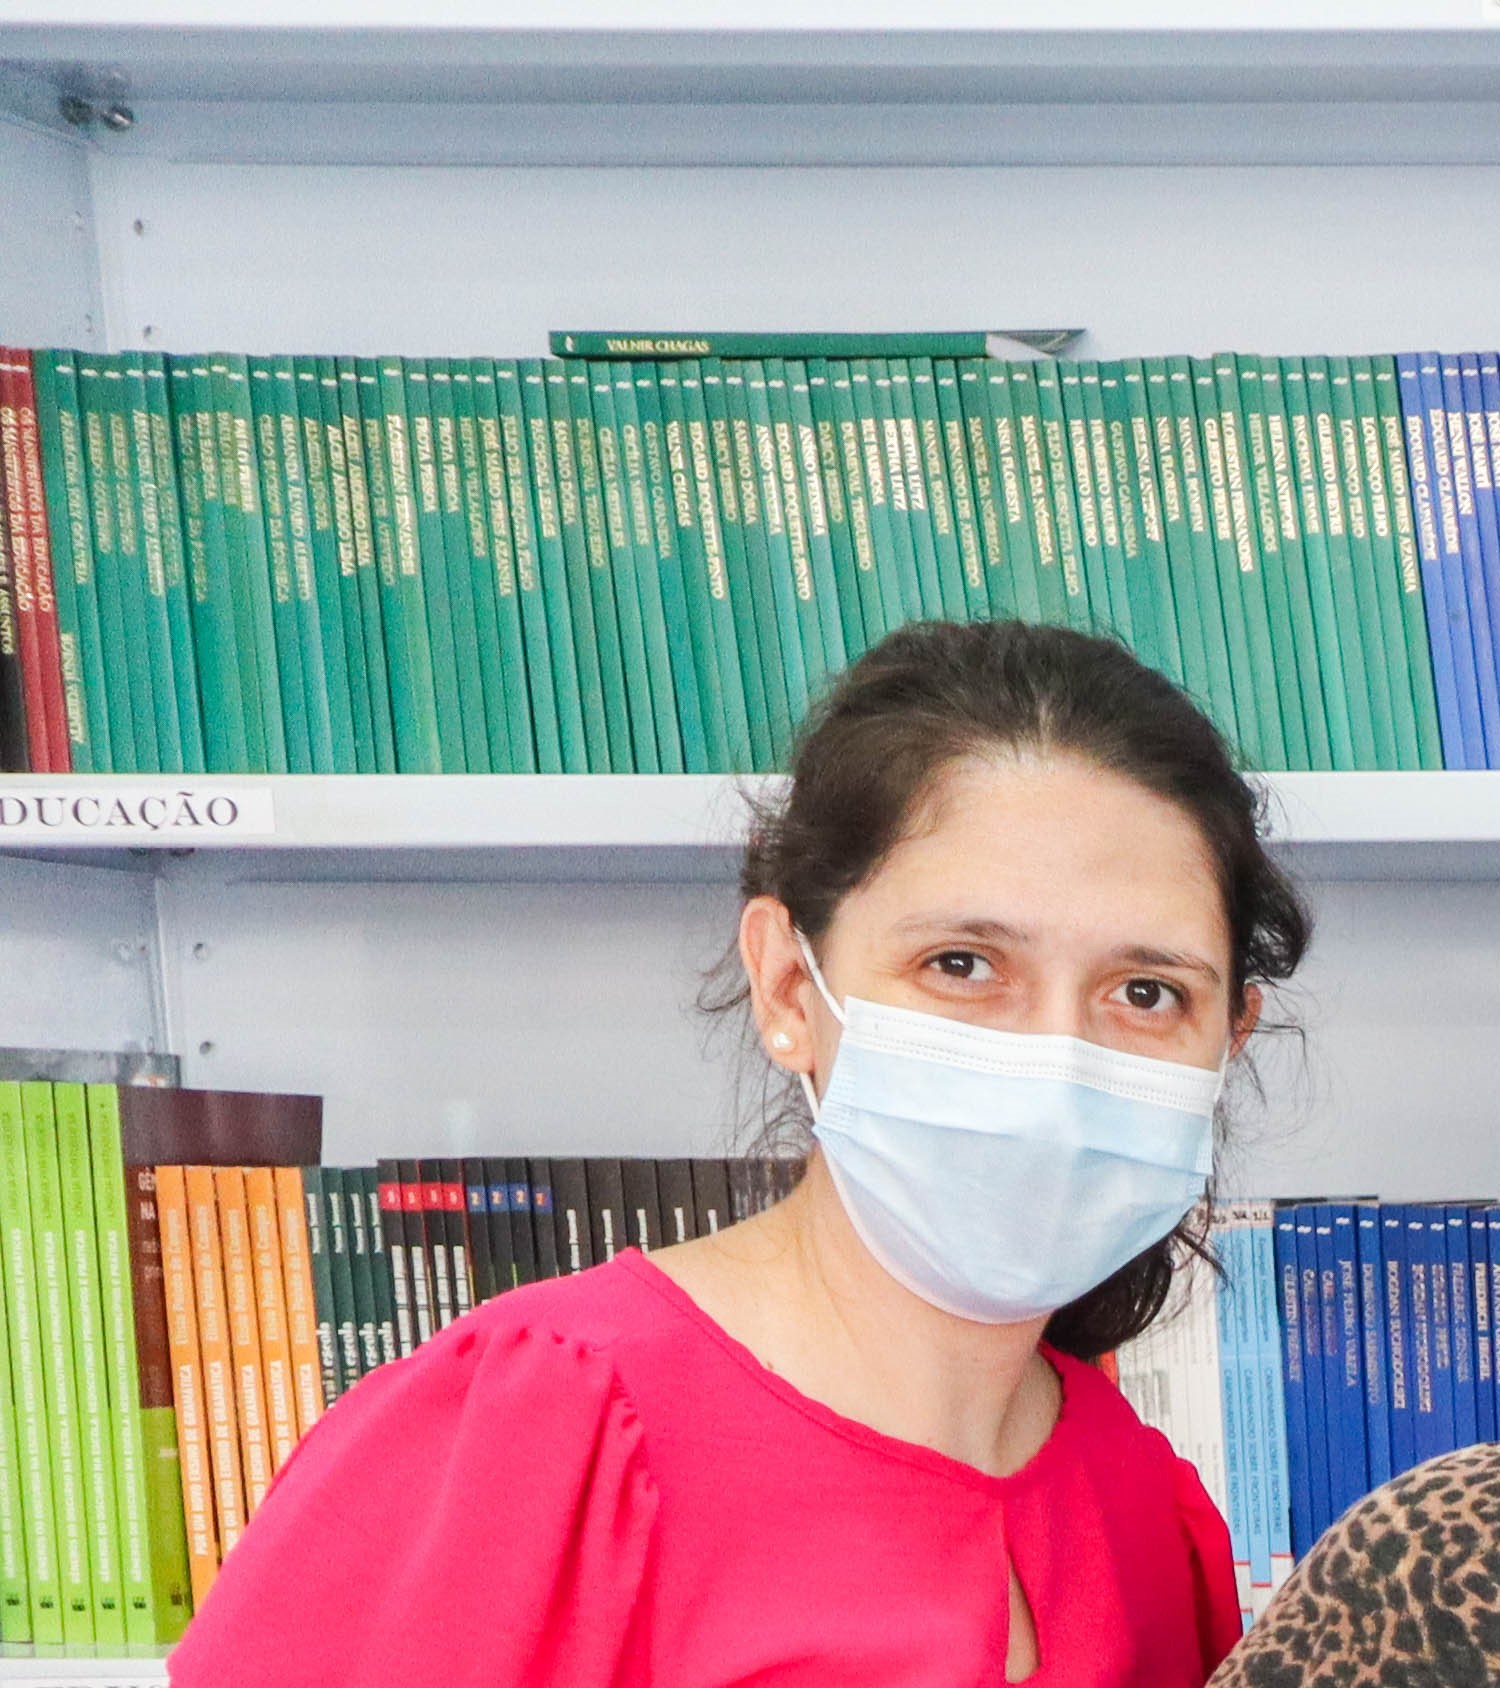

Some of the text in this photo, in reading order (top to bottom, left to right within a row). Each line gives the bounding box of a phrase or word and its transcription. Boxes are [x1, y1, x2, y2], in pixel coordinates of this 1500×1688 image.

[606, 339, 710, 353] VALNIR CHAGAS
[0, 793, 239, 831] DUCAÇÃO
[315, 1322, 333, 1367] escola
[337, 1322, 357, 1366] escola
[180, 1365, 195, 1425] GRAMÁTICA
